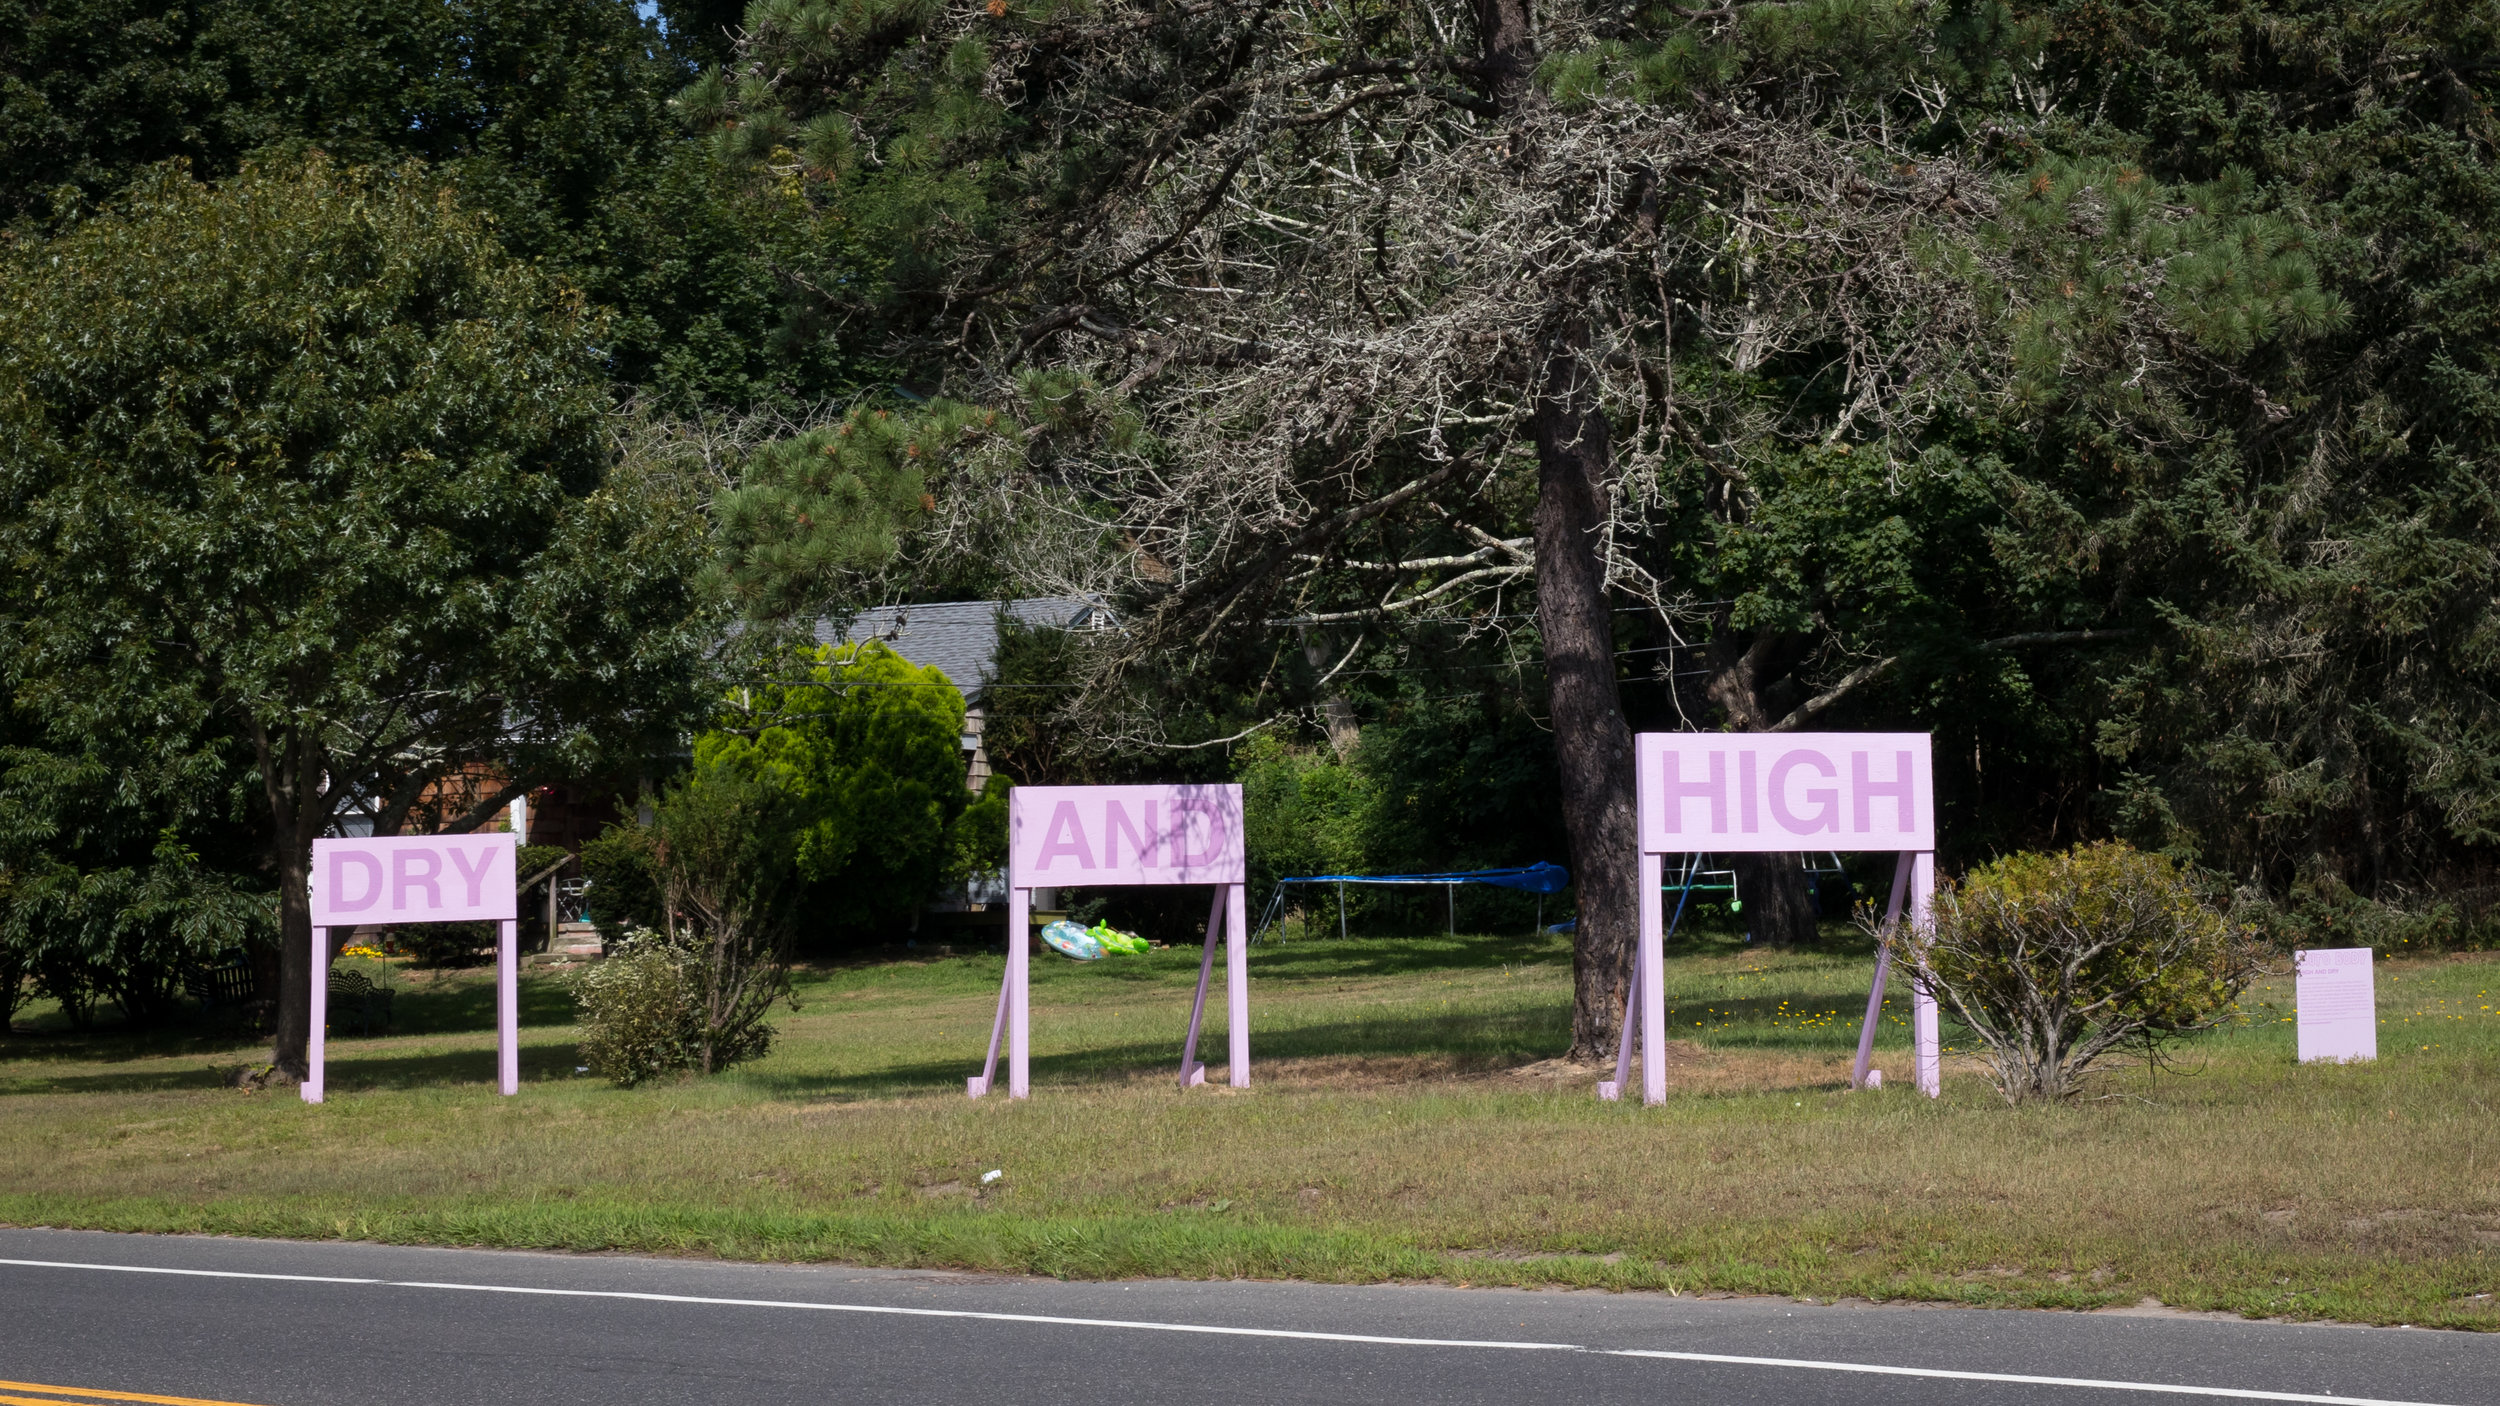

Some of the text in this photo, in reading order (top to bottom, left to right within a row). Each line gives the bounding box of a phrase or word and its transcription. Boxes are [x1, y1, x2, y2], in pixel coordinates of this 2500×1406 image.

[1662, 749, 1915, 835] HIGH
[1035, 799, 1225, 870] AND
[329, 847, 499, 912] DRY
[2302, 952, 2331, 967] UTO
